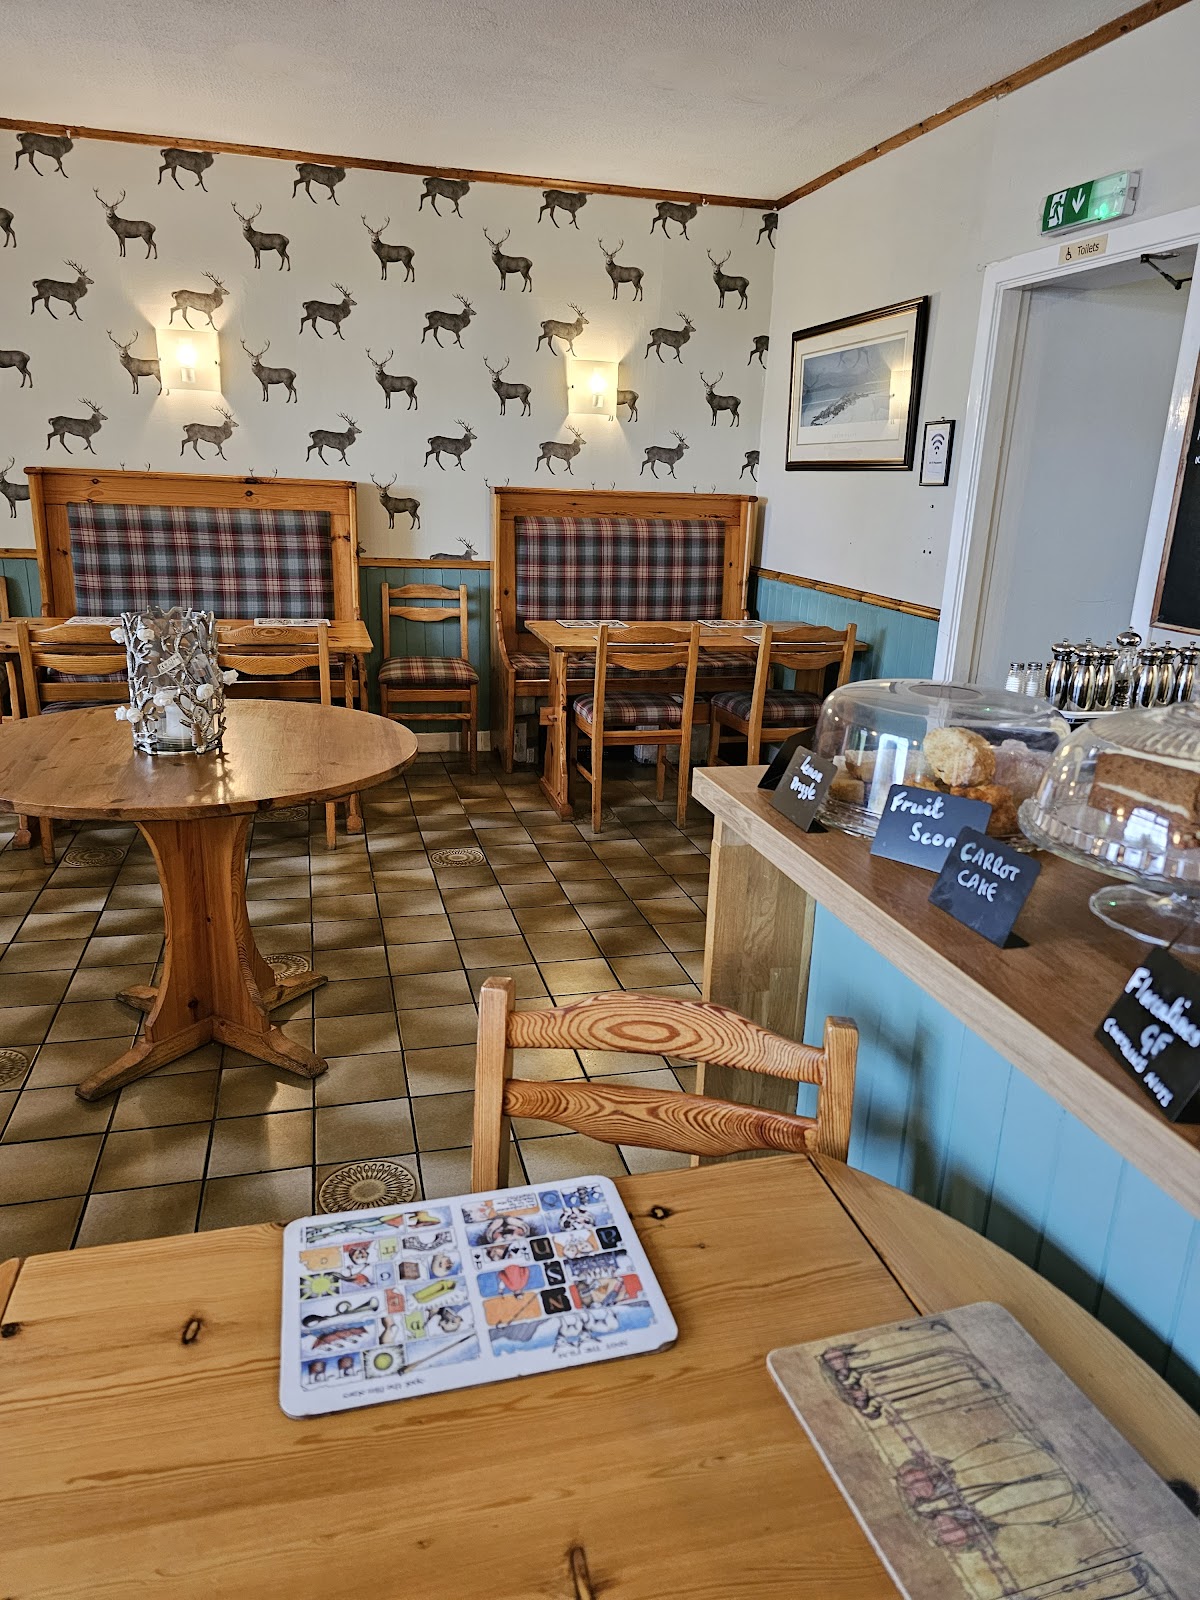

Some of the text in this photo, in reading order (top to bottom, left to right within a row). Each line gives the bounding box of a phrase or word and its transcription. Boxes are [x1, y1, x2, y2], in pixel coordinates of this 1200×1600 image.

[1077, 243, 1100, 256] Toilets
[890, 791, 945, 819] Fruit
[908, 821, 957, 848] Scon
[960, 842, 1021, 882] CARROT
[957, 869, 998, 902] CAKE
[1143, 1071, 1174, 1108] NUTS
